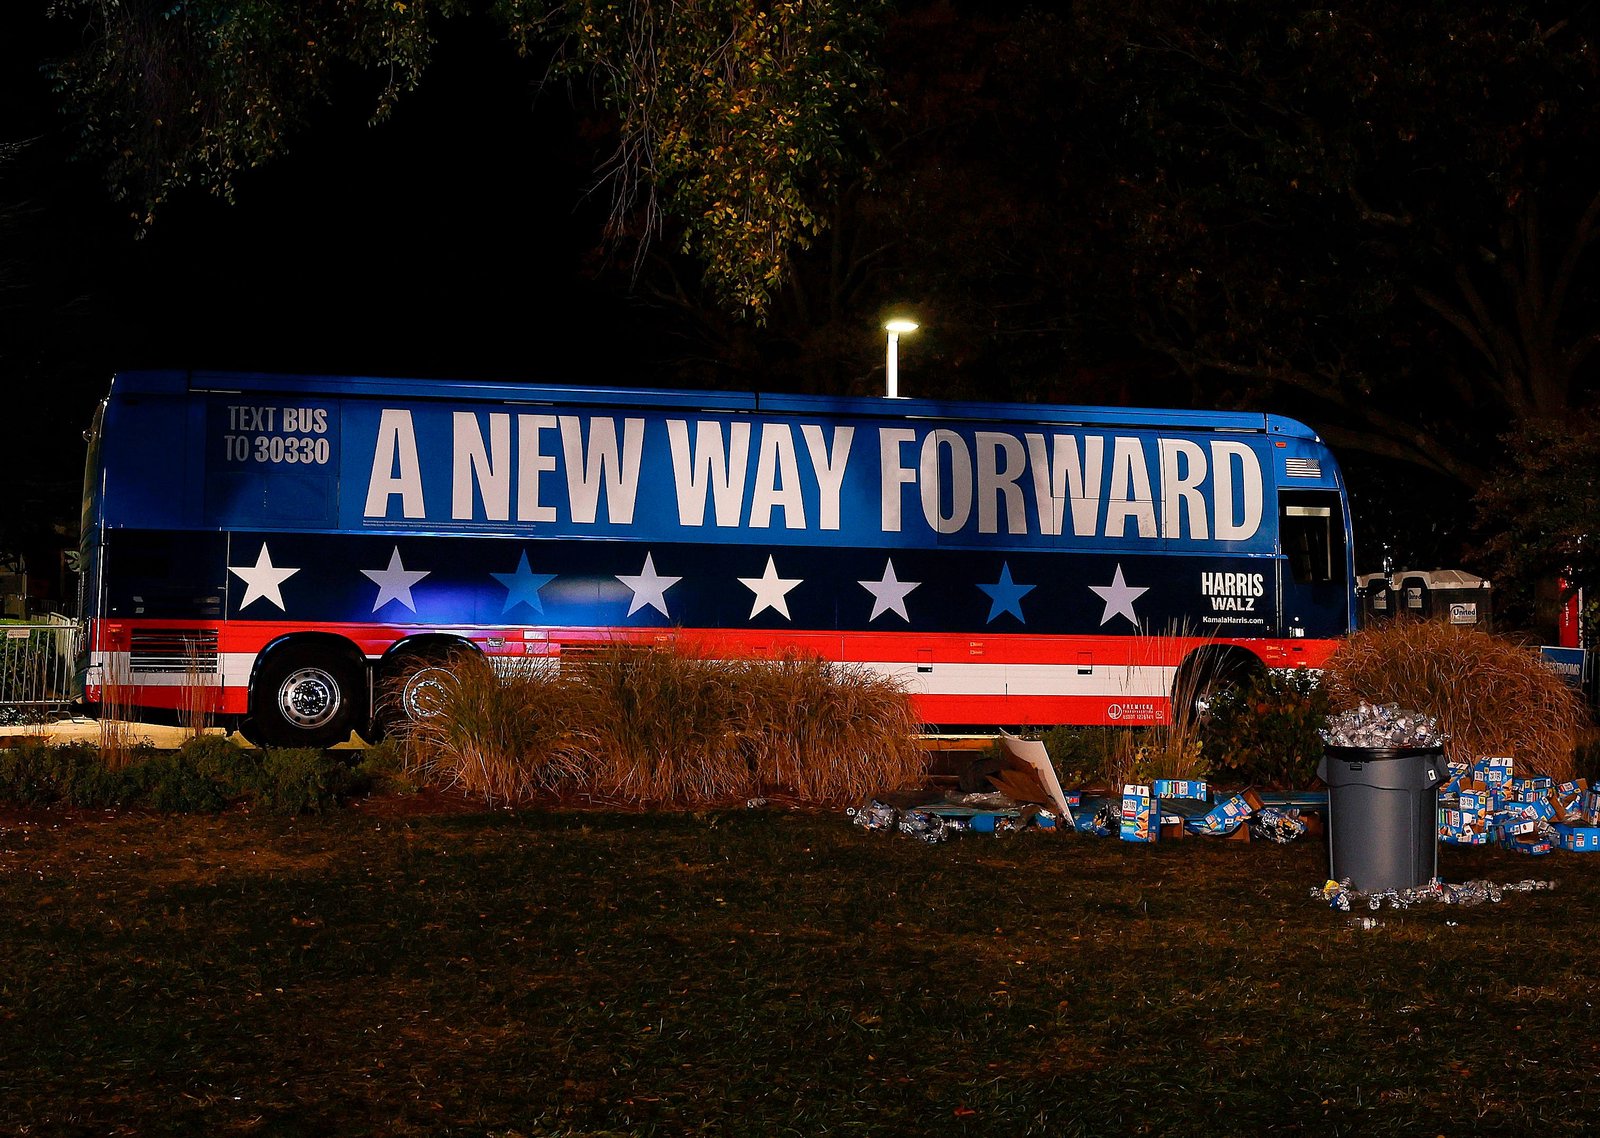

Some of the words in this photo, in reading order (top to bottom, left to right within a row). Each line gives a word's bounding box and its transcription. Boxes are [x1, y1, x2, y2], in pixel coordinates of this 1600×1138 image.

[227, 405, 277, 432] TEXT
[283, 407, 328, 434] BUS
[224, 435, 250, 462] TO
[254, 436, 330, 465] 30330
[364, 408, 426, 519] A
[452, 411, 646, 526] NEW
[666, 418, 855, 531] WAY
[879, 426, 1263, 541] FORWARD
[1201, 572, 1264, 597] HARRIS
[1211, 597, 1255, 611] WALZ
[1453, 608, 1476, 616] United
[1202, 616, 1264, 624] KamalaHarris.com
